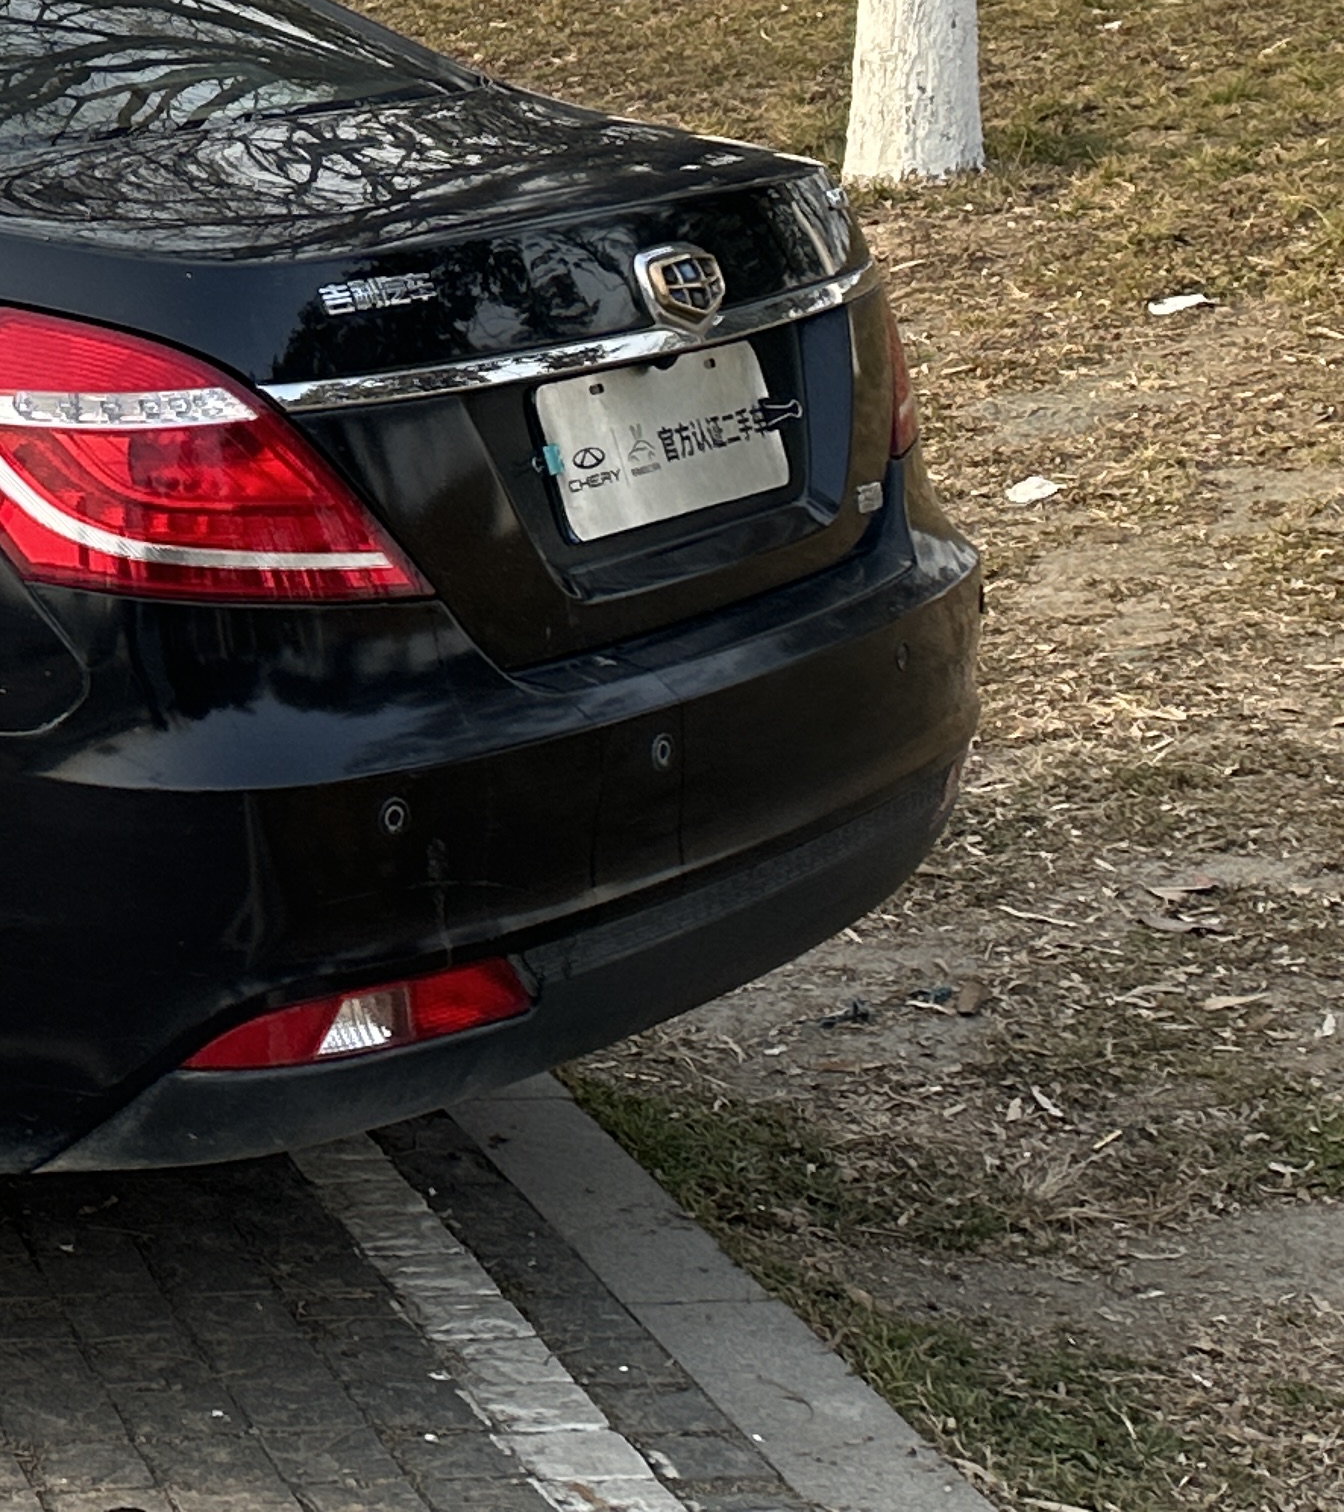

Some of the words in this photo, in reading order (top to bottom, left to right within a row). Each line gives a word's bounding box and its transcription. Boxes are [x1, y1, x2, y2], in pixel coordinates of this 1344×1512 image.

[318, 272, 438, 316] 吉利汽车
[568, 468, 622, 494] CHERY
